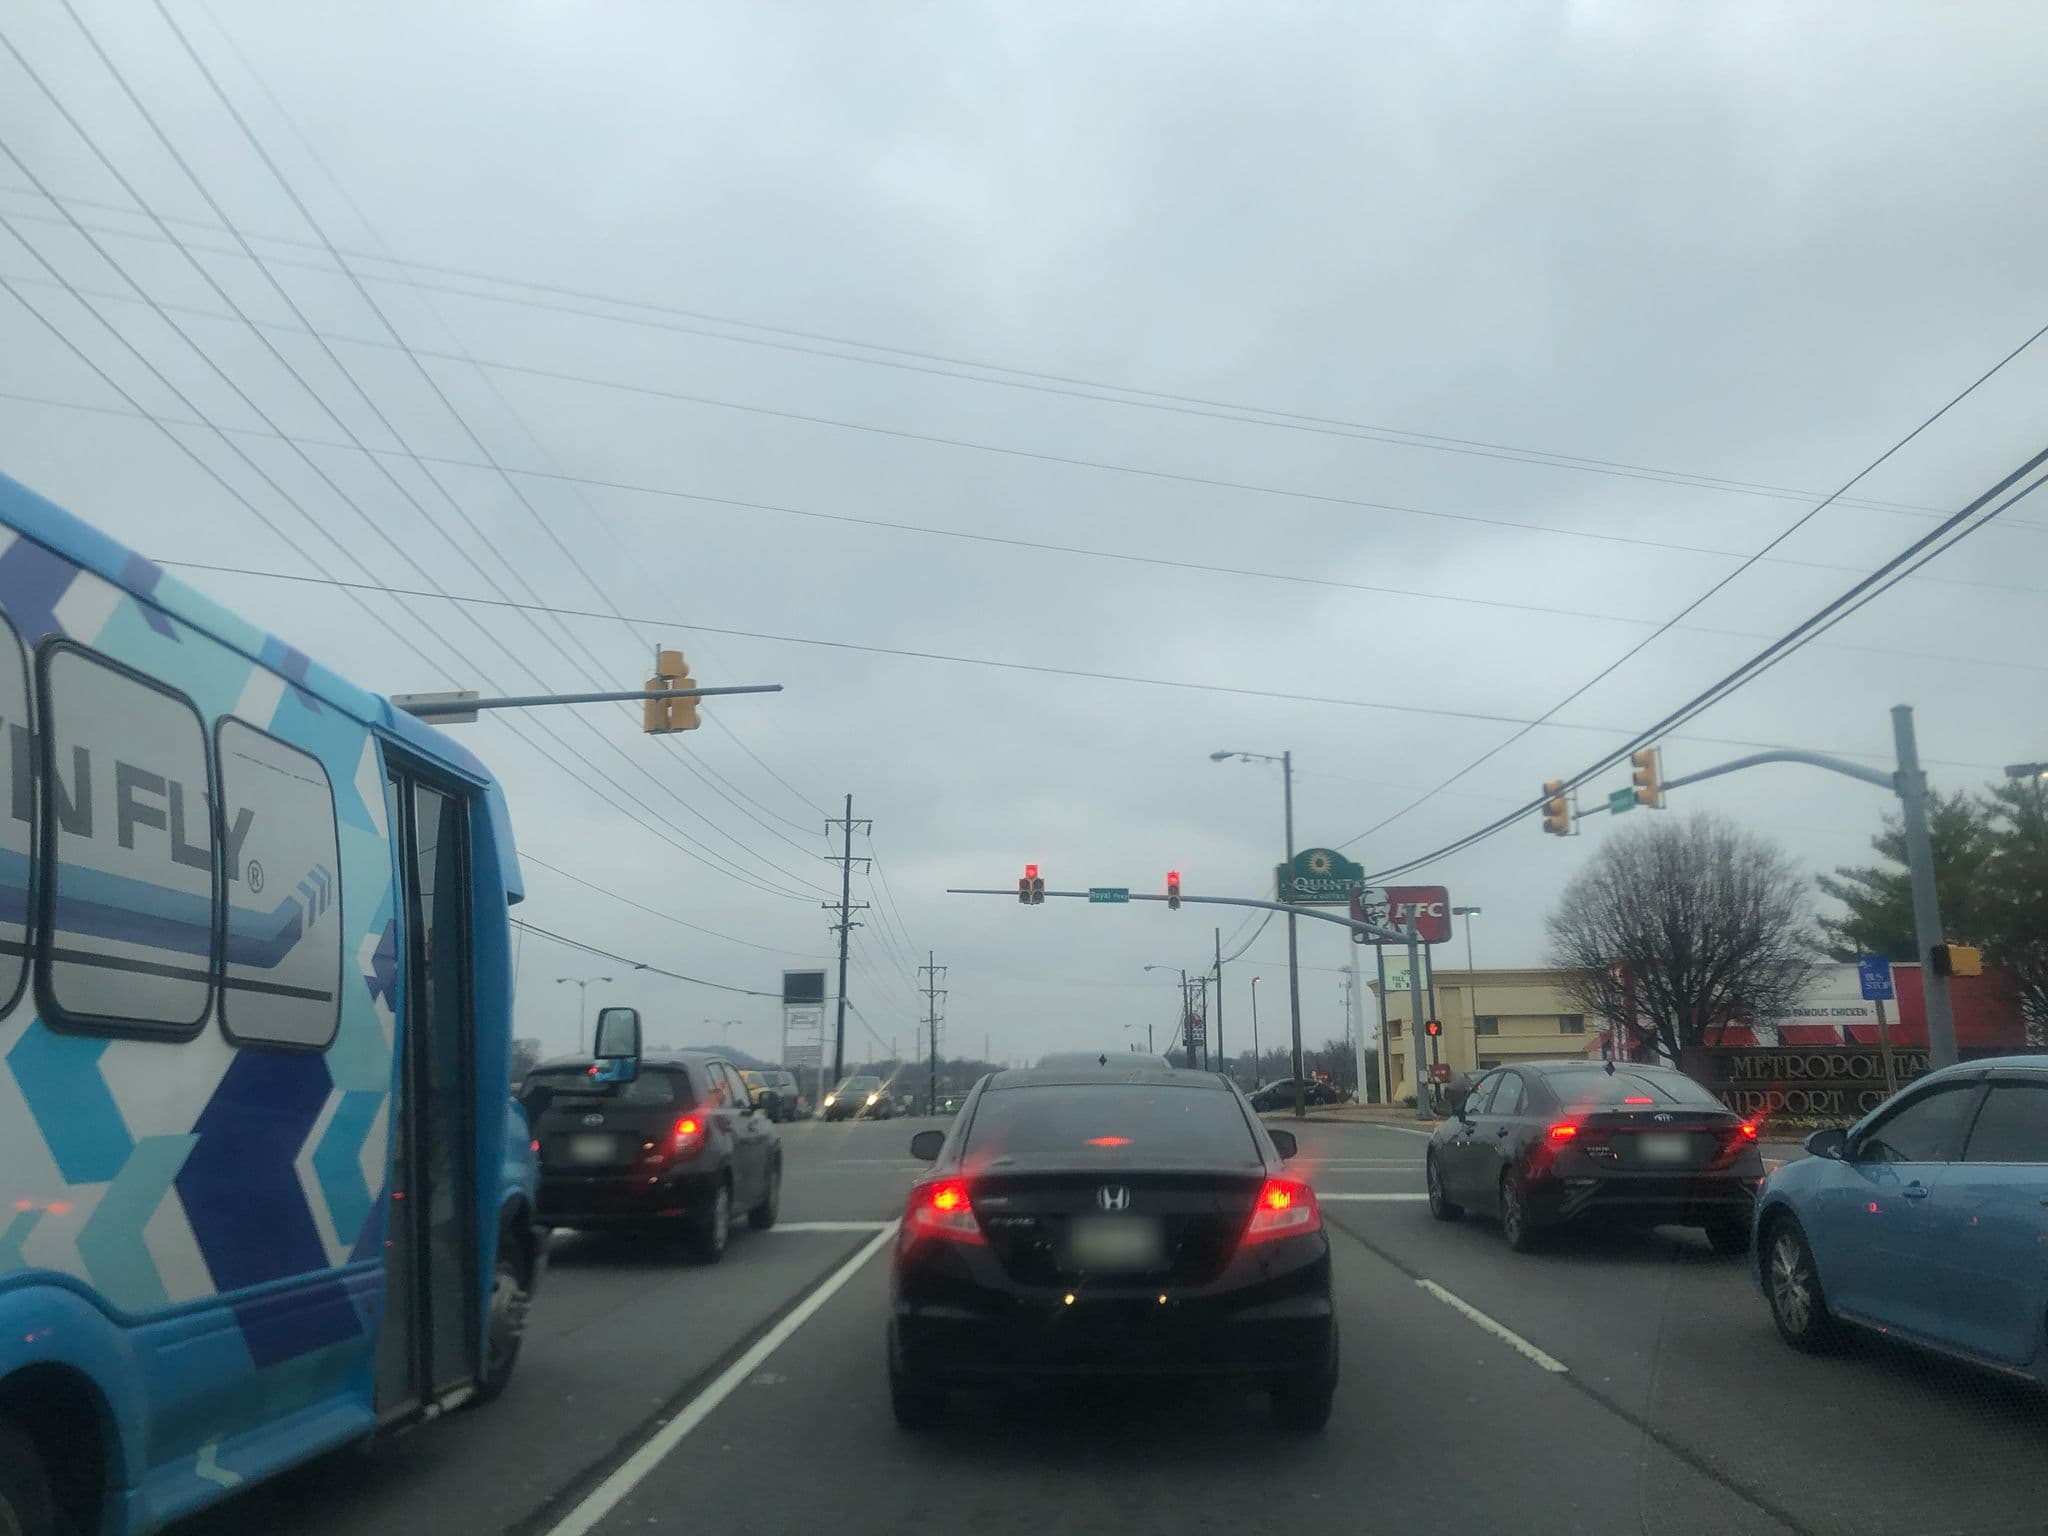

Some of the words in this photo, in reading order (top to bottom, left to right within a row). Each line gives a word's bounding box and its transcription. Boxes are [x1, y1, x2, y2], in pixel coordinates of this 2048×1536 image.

[115, 759, 255, 881] FLY
[1395, 902, 1444, 918] KFC
[1791, 1007, 1830, 1017] FAMOUS
[1831, 1007, 1868, 1017] CHICKEN
[1731, 1055, 1933, 1080] METROPOLTAN
[1721, 1089, 1844, 1116] AIRPORT
